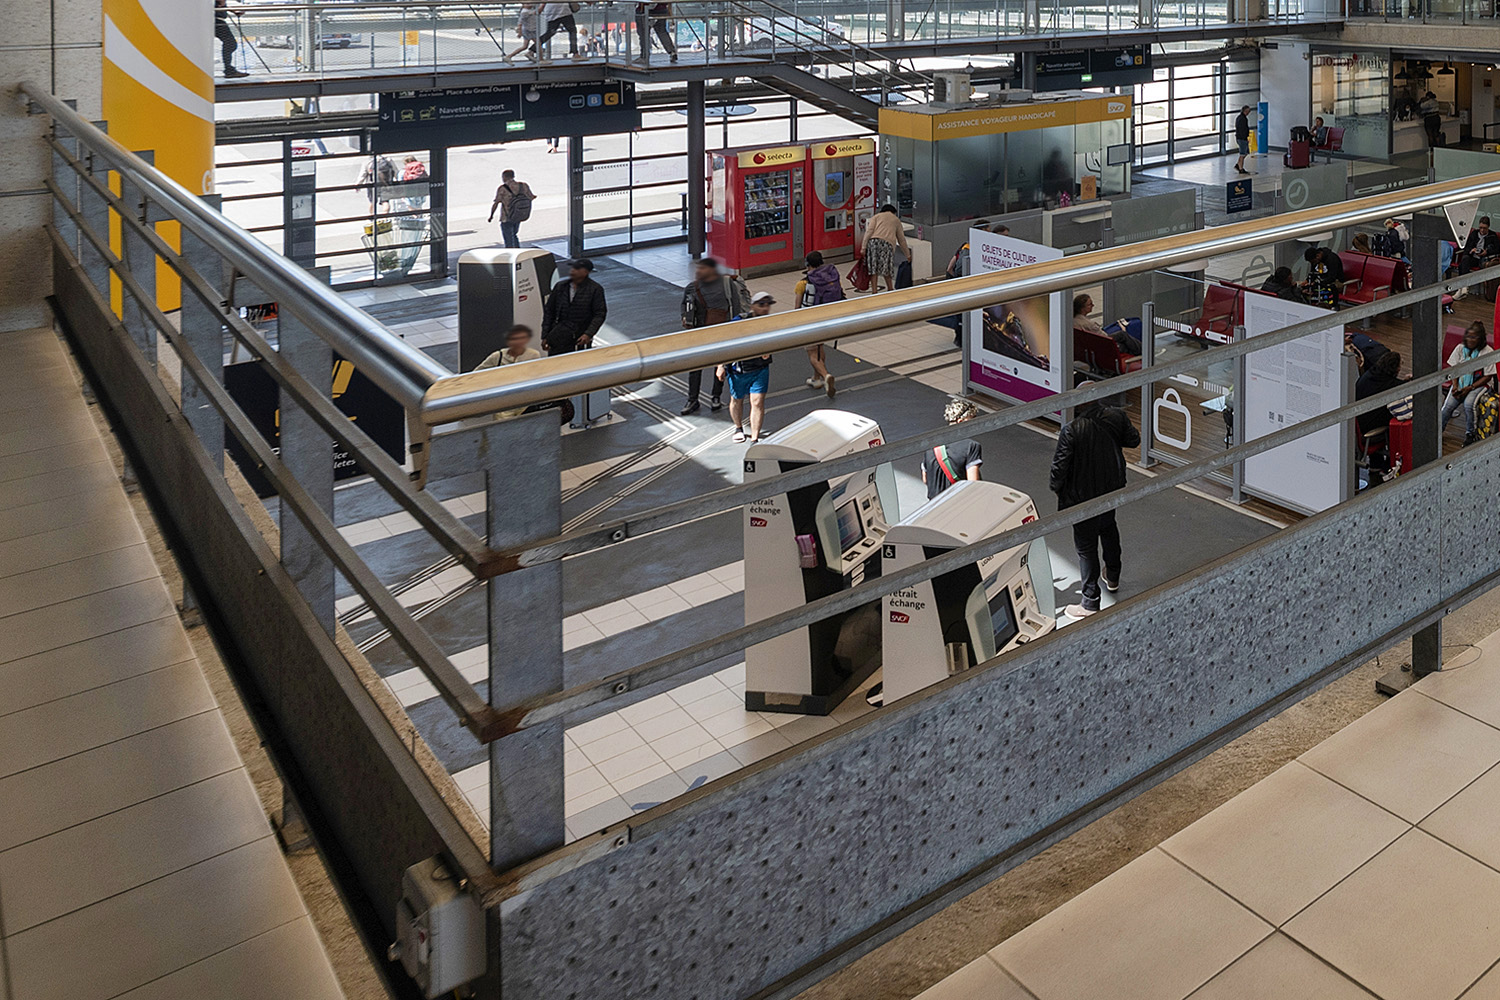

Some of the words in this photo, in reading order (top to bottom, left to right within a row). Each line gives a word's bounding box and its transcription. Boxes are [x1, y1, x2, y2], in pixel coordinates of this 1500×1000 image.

[439, 106, 471, 114] Navette
[472, 103, 505, 113] aéroport
[937, 119, 979, 130] ASSISTANCE
[981, 114, 1018, 125] VOYAGEUR
[1018, 110, 1056, 121] HANDICAPÉ
[838, 144, 862, 152] selecta
[767, 152, 793, 161] selecta
[981, 243, 1002, 257] OBJETS
[1003, 249, 1011, 259] DE
[981, 254, 1012, 268] MATÉRIAUX
[749, 506, 781, 516] échange
[889, 598, 926, 610] échange
